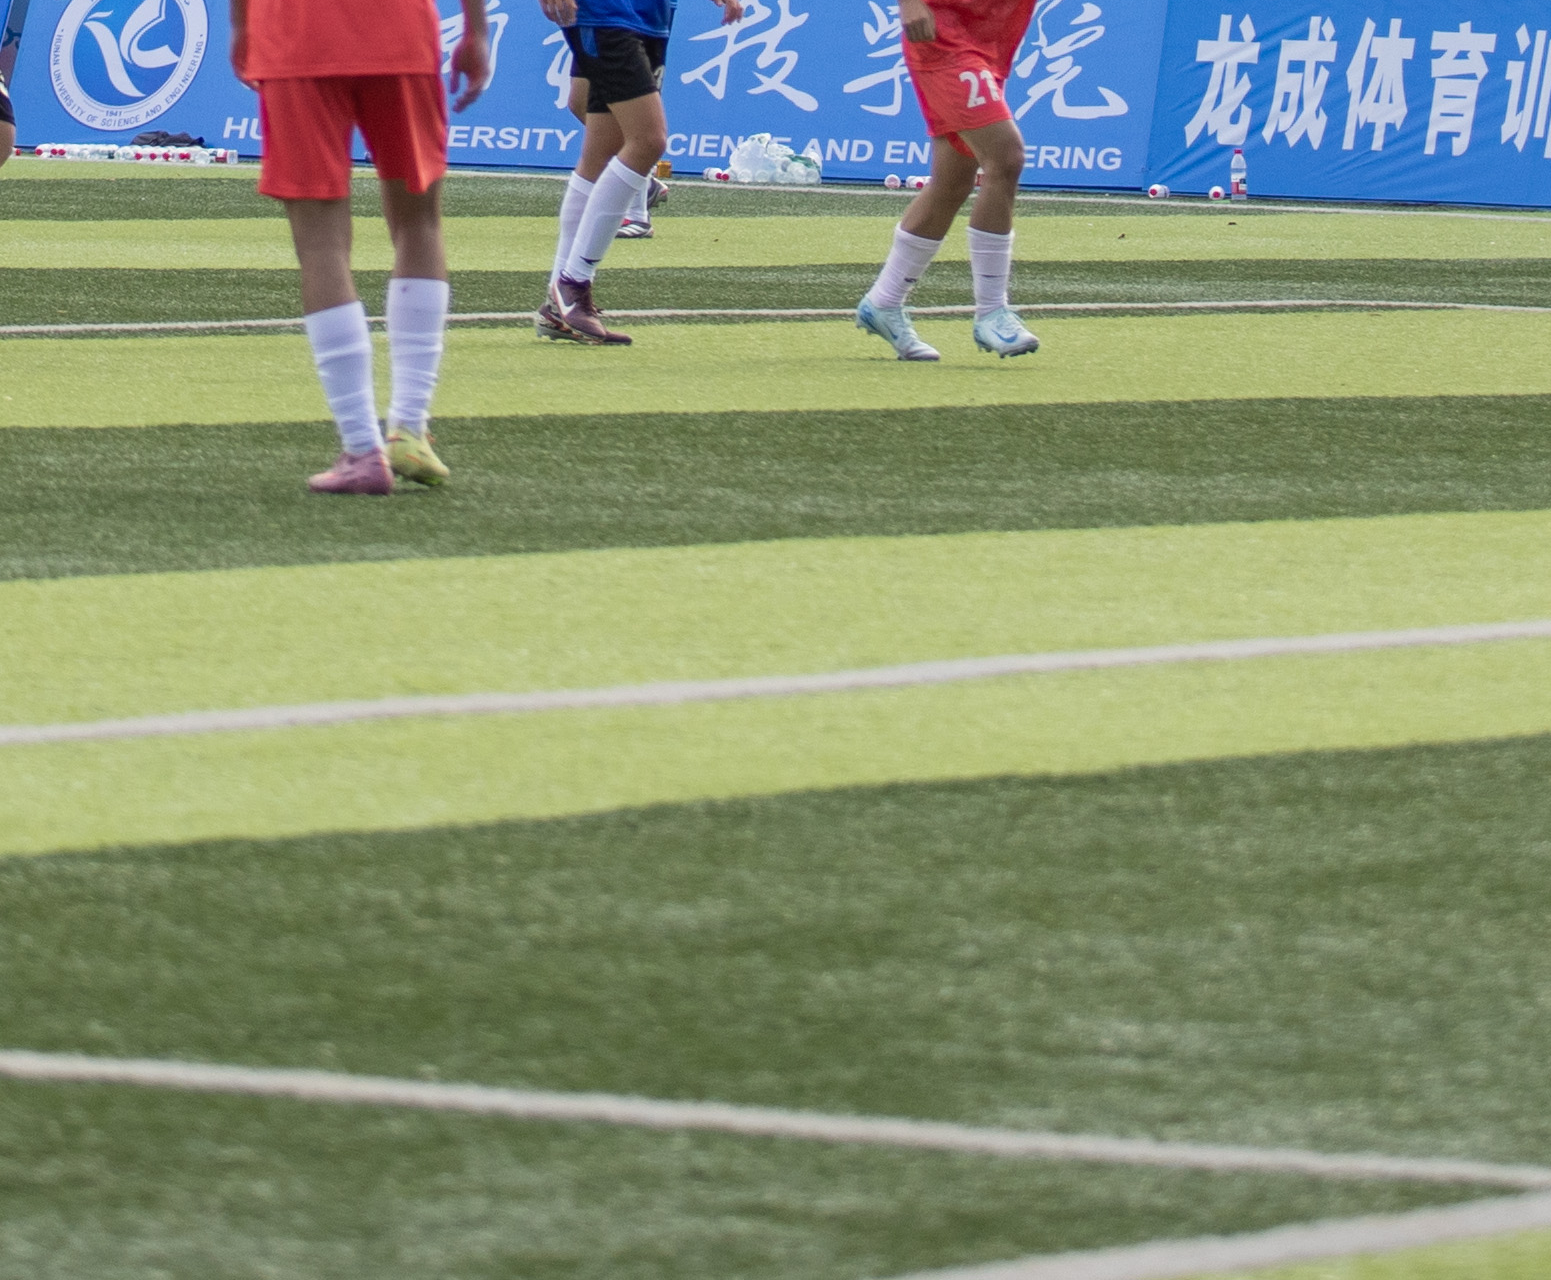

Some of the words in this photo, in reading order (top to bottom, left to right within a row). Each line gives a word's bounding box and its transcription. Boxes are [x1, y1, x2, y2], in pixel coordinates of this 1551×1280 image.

[51, 34, 64, 66] HUNAN
[165, 41, 205, 105] ENGINEERING
[959, 70, 1002, 108] 21
[53, 70, 84, 118] UNIVERSITY
[145, 104, 163, 119] AND
[86, 114, 99, 125] OF
[100, 115, 141, 128] SCIENCE
[447, 124, 579, 152] ERSITY
[807, 137, 875, 162] AND
